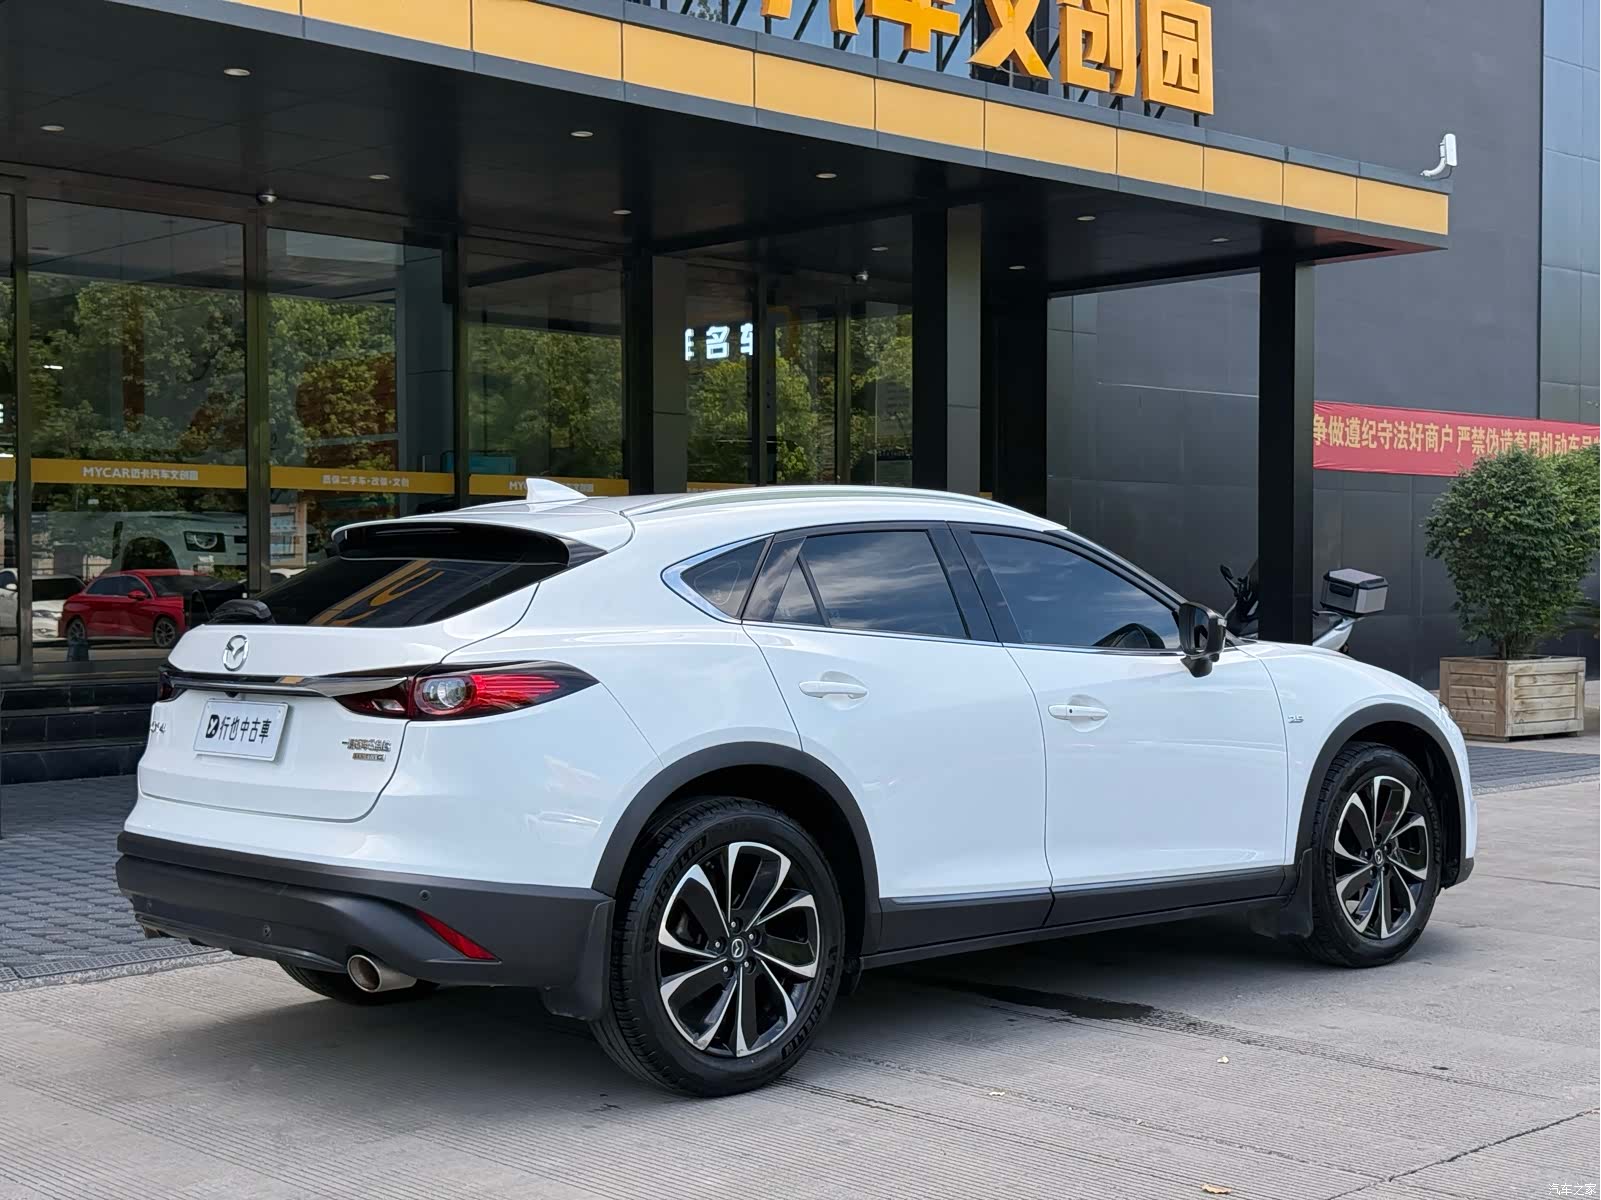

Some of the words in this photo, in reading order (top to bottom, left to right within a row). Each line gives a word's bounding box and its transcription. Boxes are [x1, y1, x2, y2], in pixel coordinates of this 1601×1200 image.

[1313, 413, 1453, 453] 争做遵纪守法好商户
[218, 715, 272, 744] 行也中古車
[650, 836, 707, 920] MICHELIN
[783, 972, 834, 1056] MICHELIN
